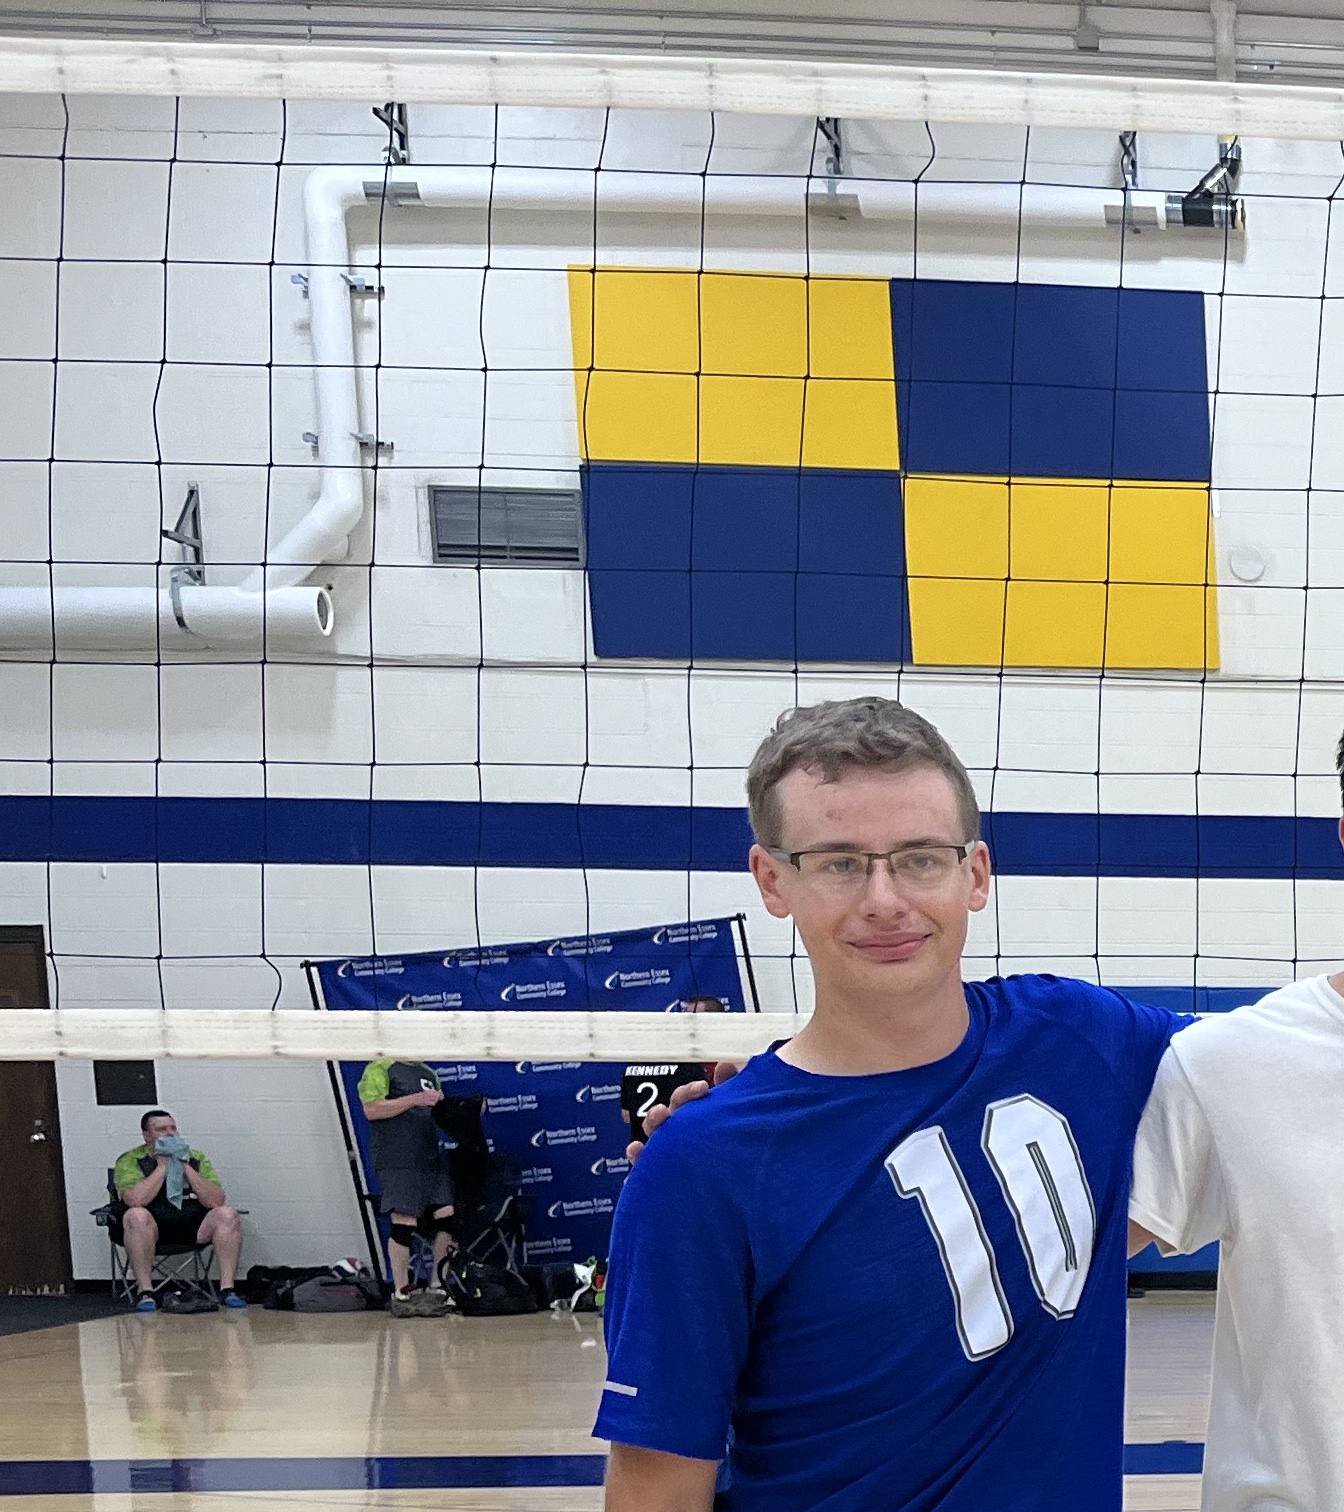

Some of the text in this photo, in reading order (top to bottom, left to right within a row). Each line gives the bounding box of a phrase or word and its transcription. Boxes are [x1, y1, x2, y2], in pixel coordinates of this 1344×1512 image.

[625, 1065, 678, 1076] KENNEDY
[637, 1082, 658, 1117] 2
[884, 1093, 1096, 1362] 10
